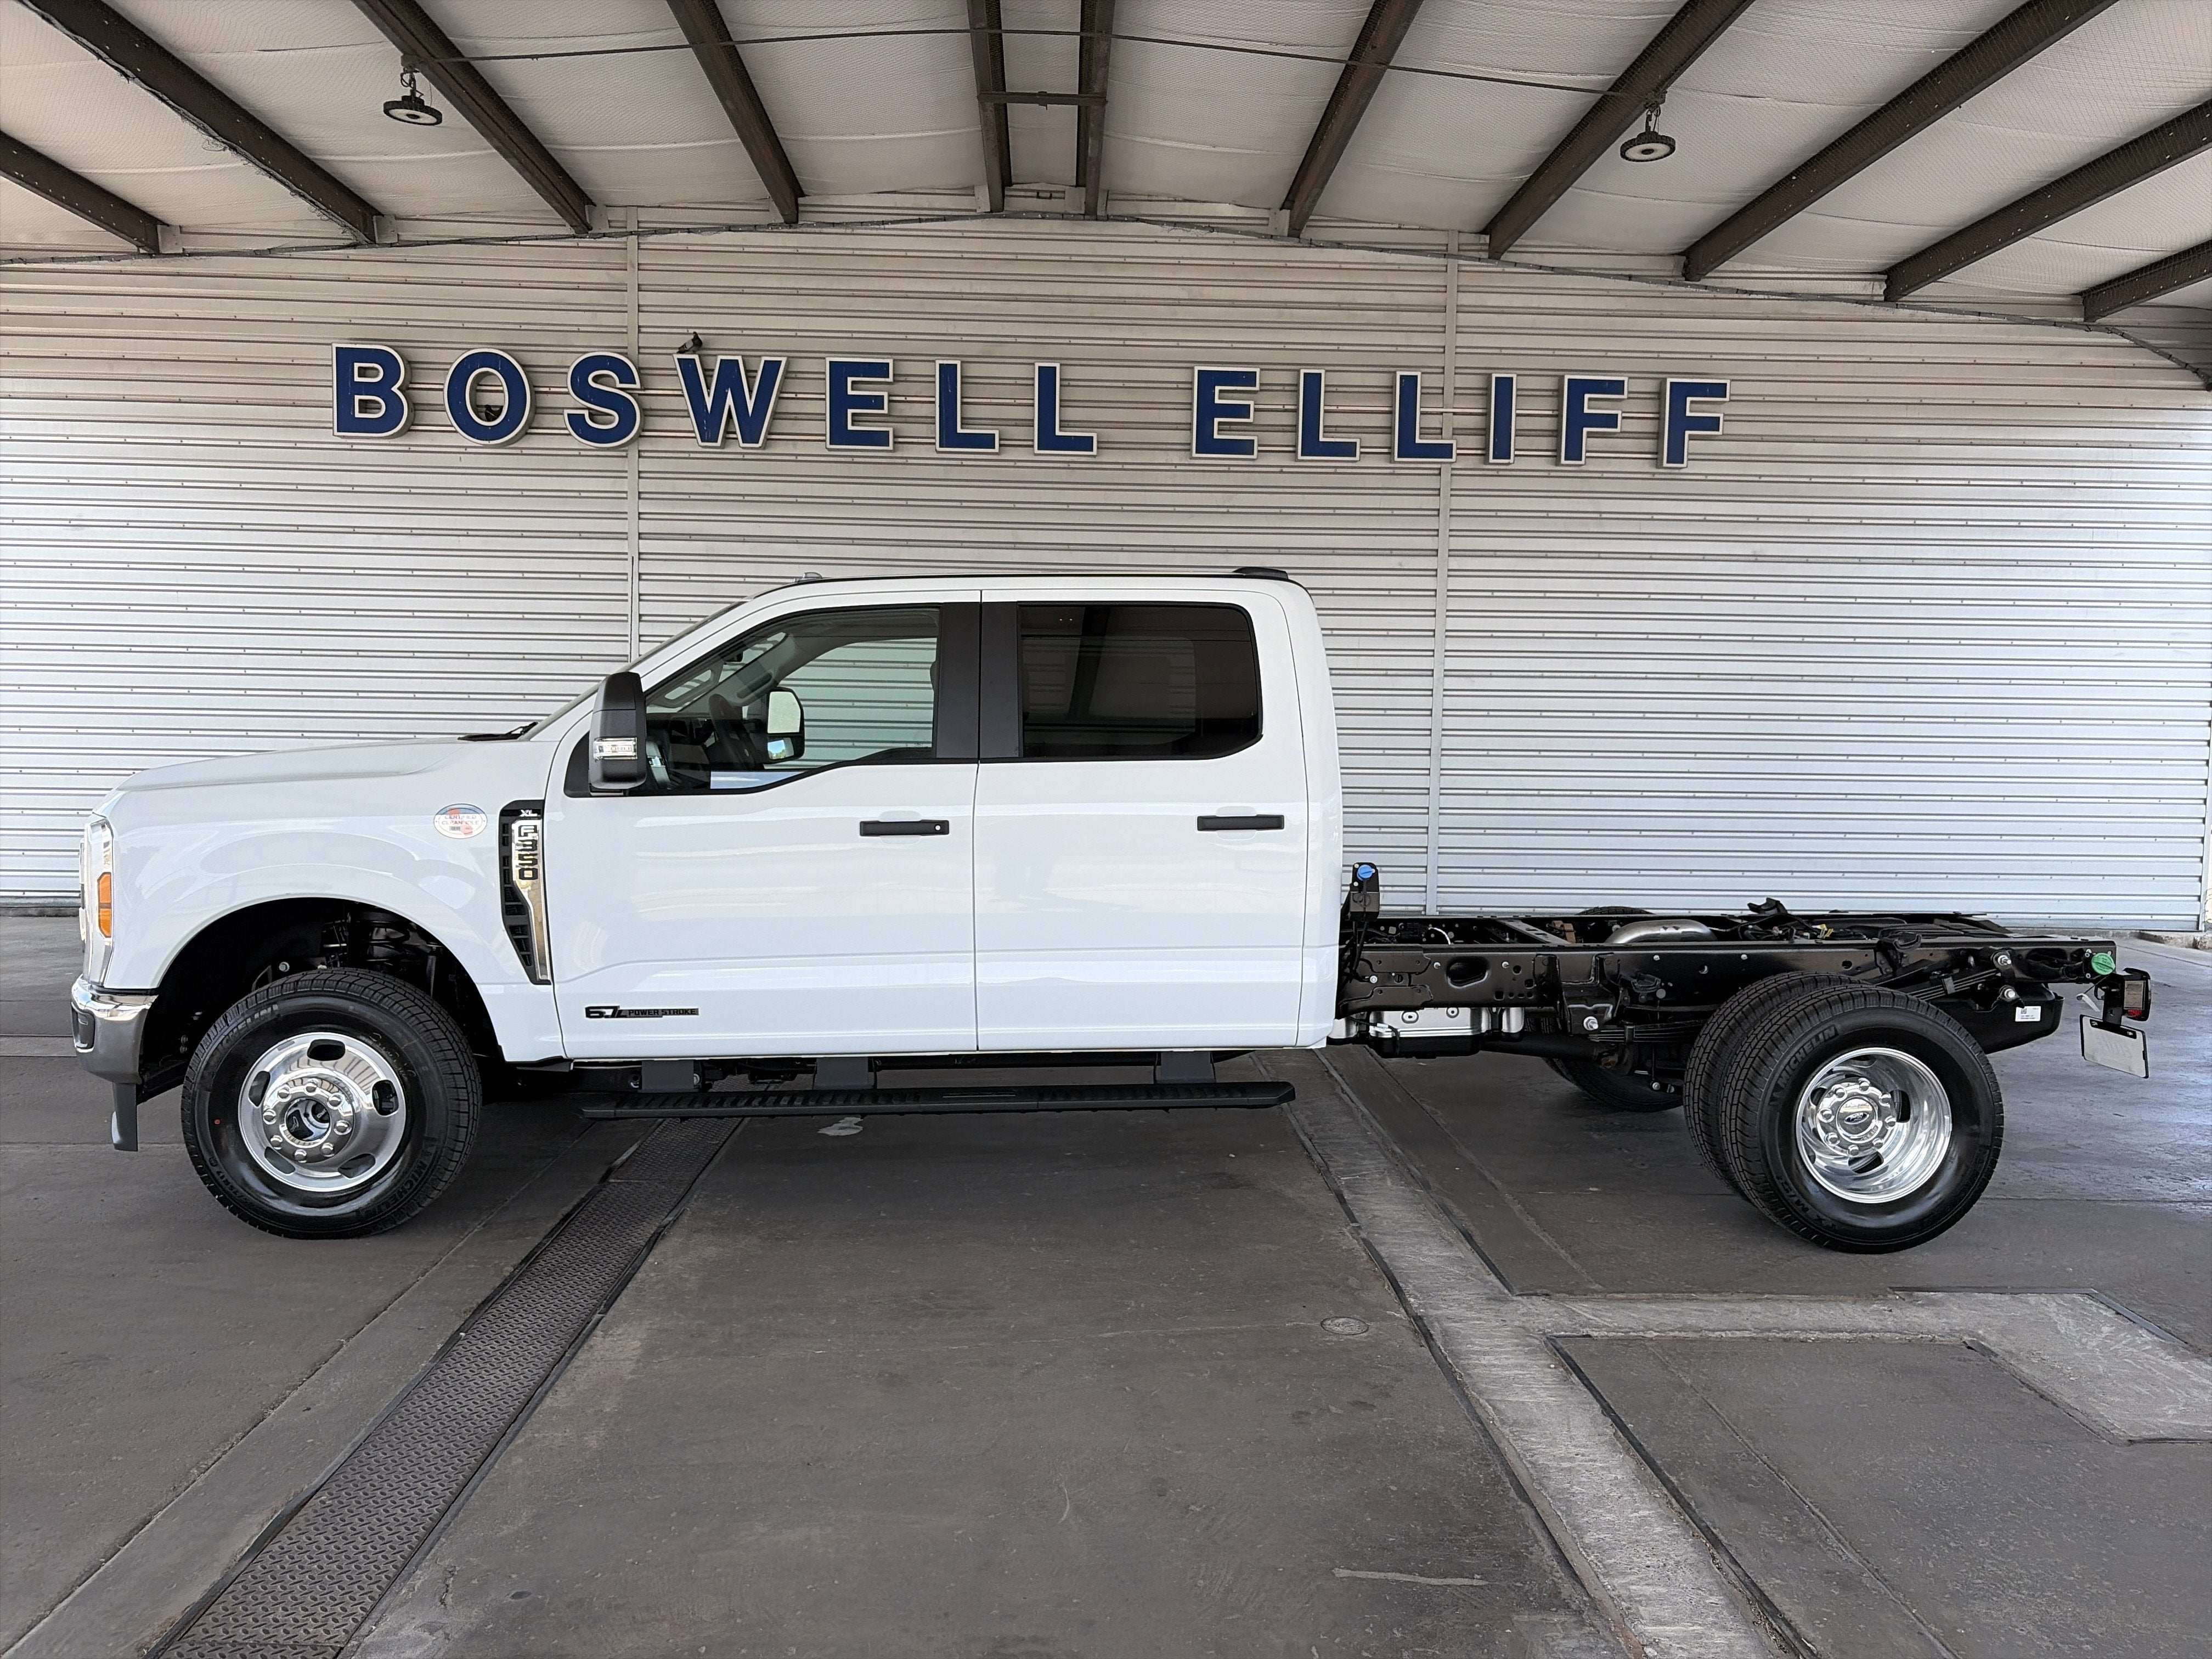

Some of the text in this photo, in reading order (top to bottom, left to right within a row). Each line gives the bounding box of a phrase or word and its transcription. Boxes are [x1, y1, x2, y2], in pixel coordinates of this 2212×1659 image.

[332, 342, 1731, 468] BOSWELL ELLIFF
[1777, 1025, 1836, 1090] MICHELIN
